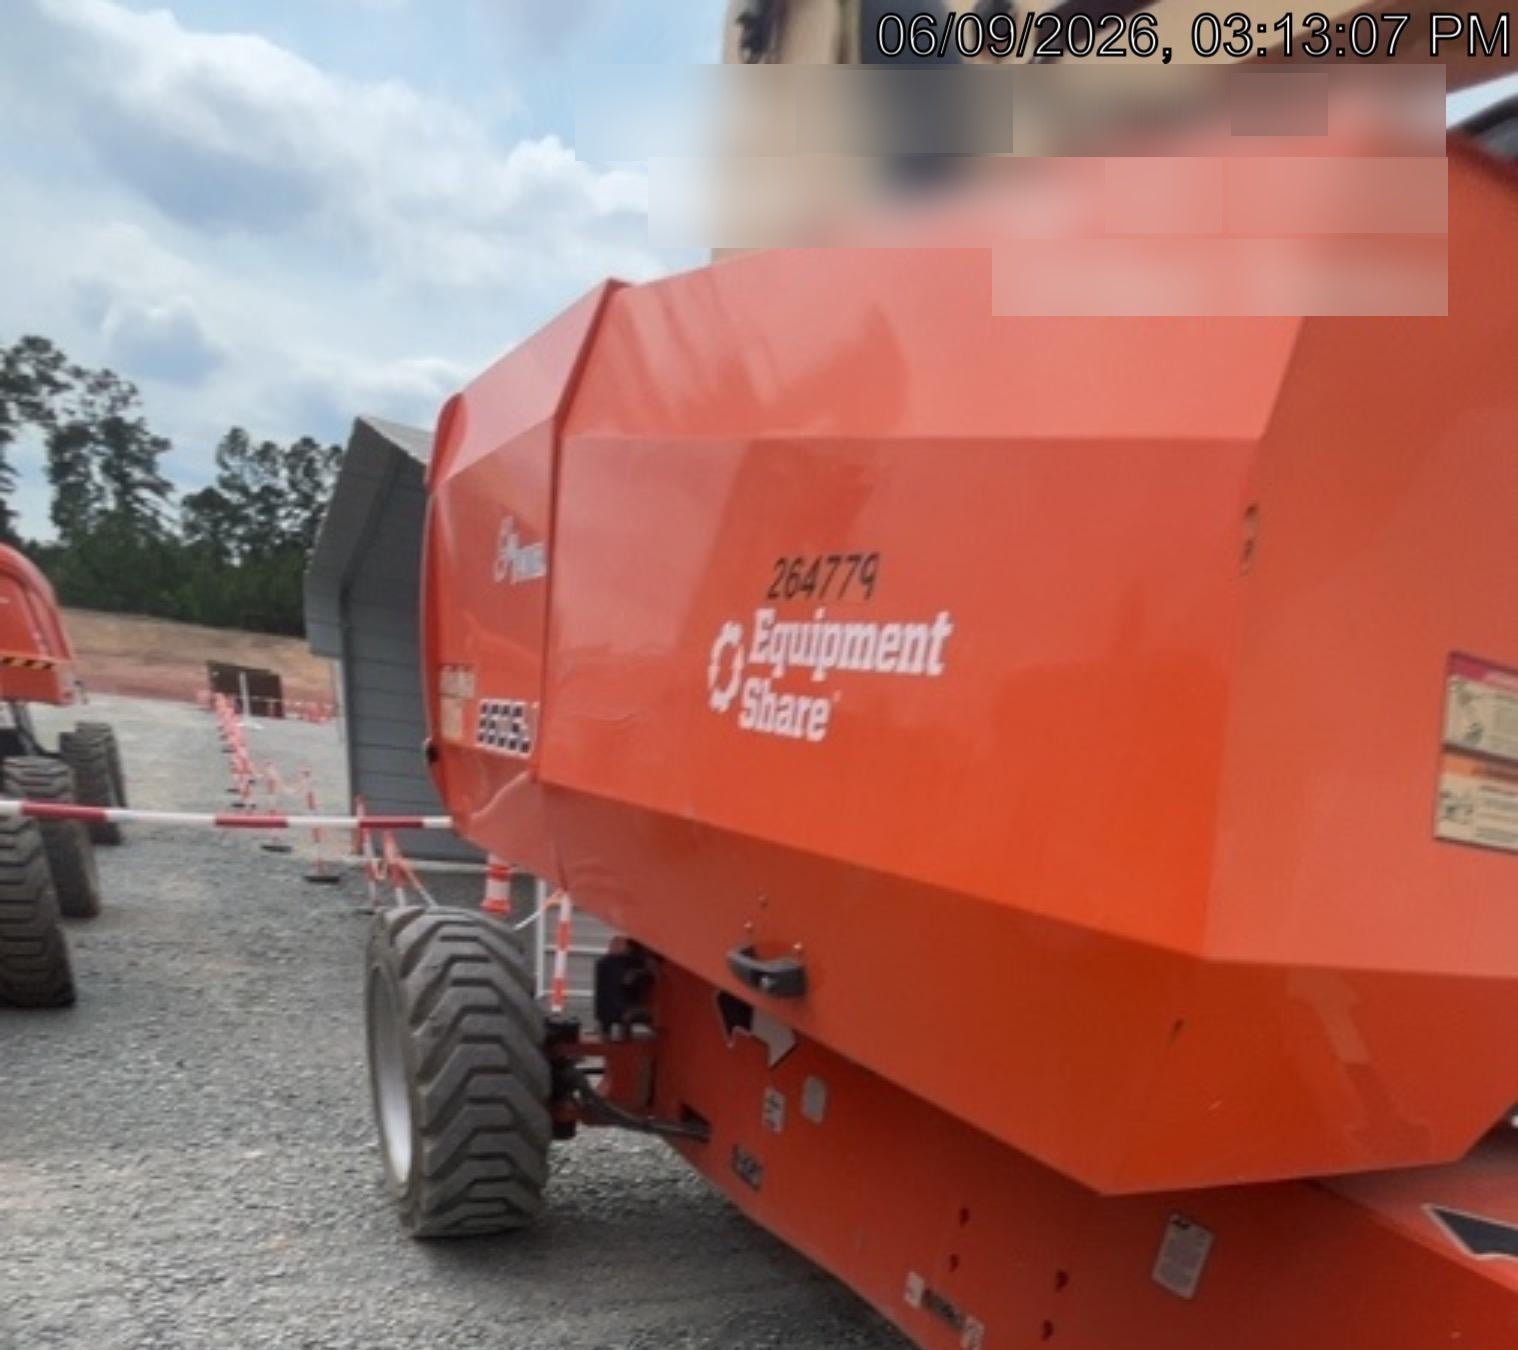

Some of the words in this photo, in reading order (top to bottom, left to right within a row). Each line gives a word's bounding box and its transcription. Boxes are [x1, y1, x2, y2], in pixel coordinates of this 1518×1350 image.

[767, 552, 880, 600] 264779
[749, 607, 954, 682] Equipment
[738, 678, 831, 742] Share
